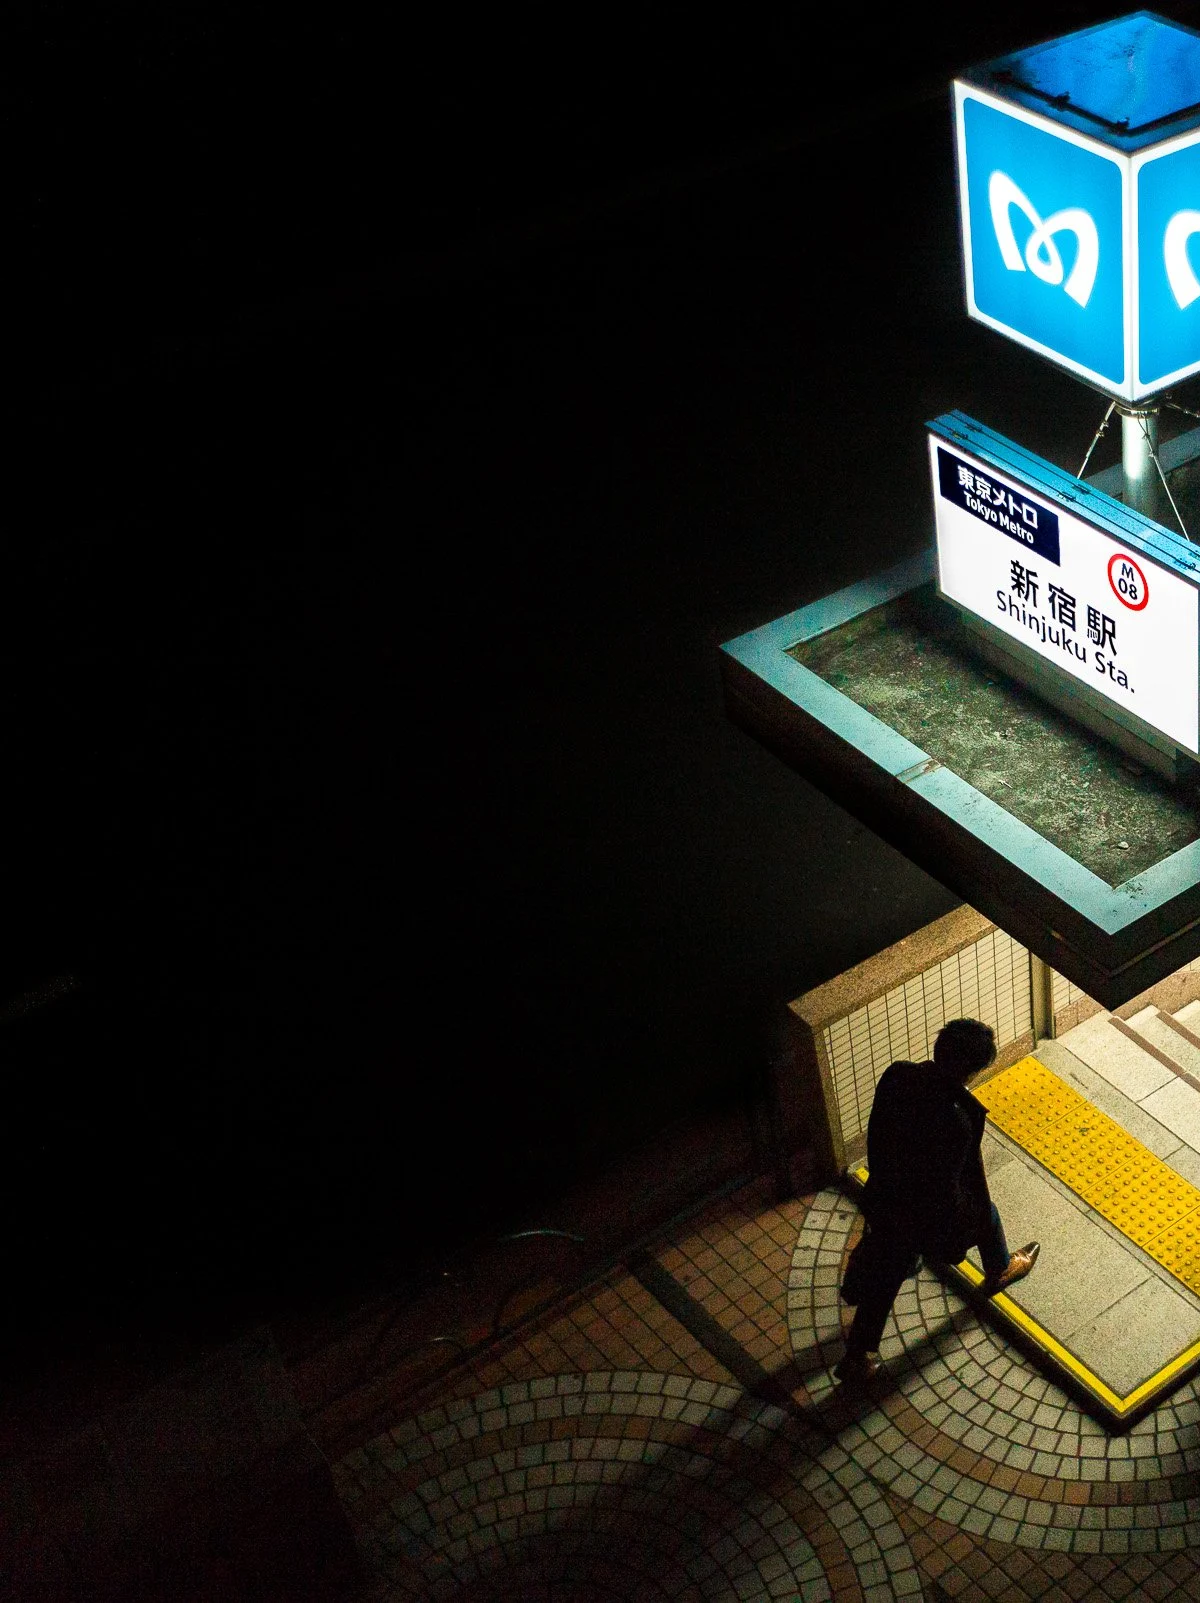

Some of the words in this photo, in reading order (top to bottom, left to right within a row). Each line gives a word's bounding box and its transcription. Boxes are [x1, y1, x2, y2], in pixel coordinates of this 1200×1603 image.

[957, 466, 1039, 530] 東京メトロ
[963, 491, 998, 523] Tokyo
[1000, 510, 1034, 544] Metro
[1118, 578, 1139, 601] 08
[1121, 563, 1135, 582] M
[1010, 559, 1118, 656] 新宿駅
[997, 590, 1087, 664] Shinjuku
[1095, 653, 1136, 694] Sta.
